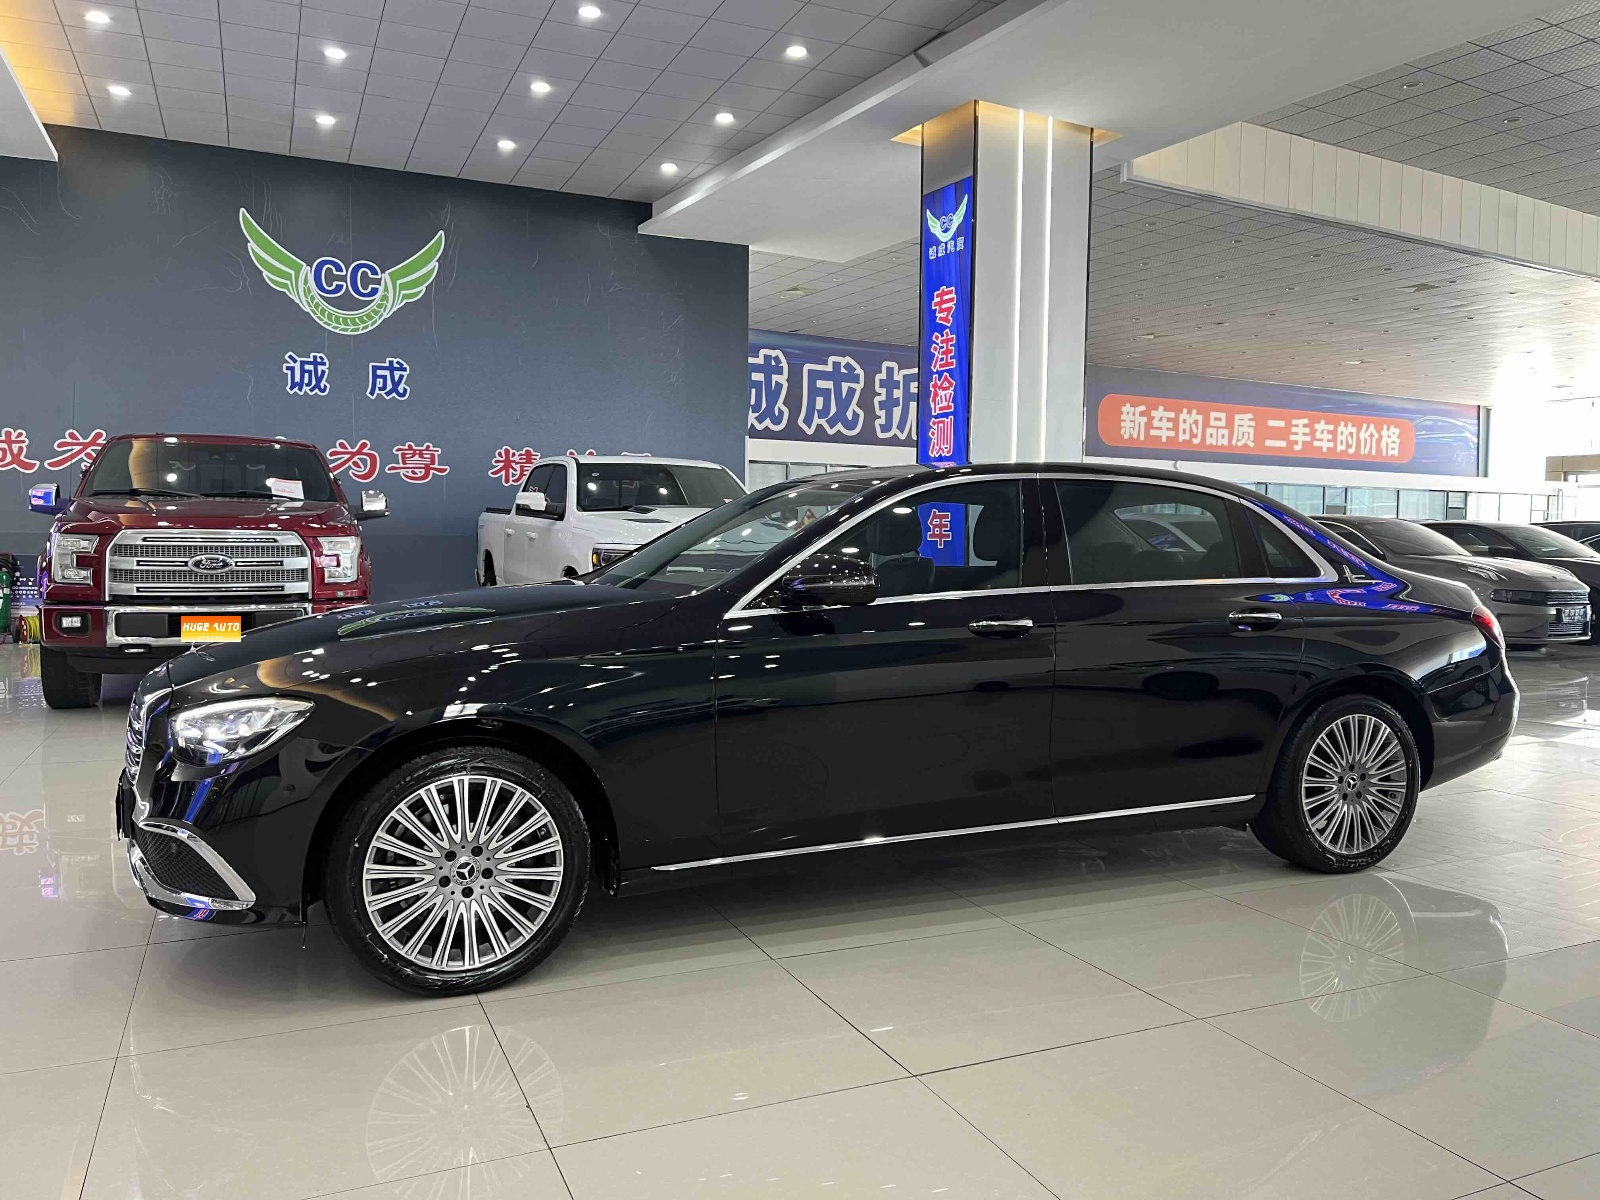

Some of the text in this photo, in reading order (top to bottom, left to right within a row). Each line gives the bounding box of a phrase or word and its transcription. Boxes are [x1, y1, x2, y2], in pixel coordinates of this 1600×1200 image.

[940, 213, 954, 231] CC
[312, 256, 382, 300] CC
[1120, 403, 1401, 457] 新车的品质 二手车的价格
